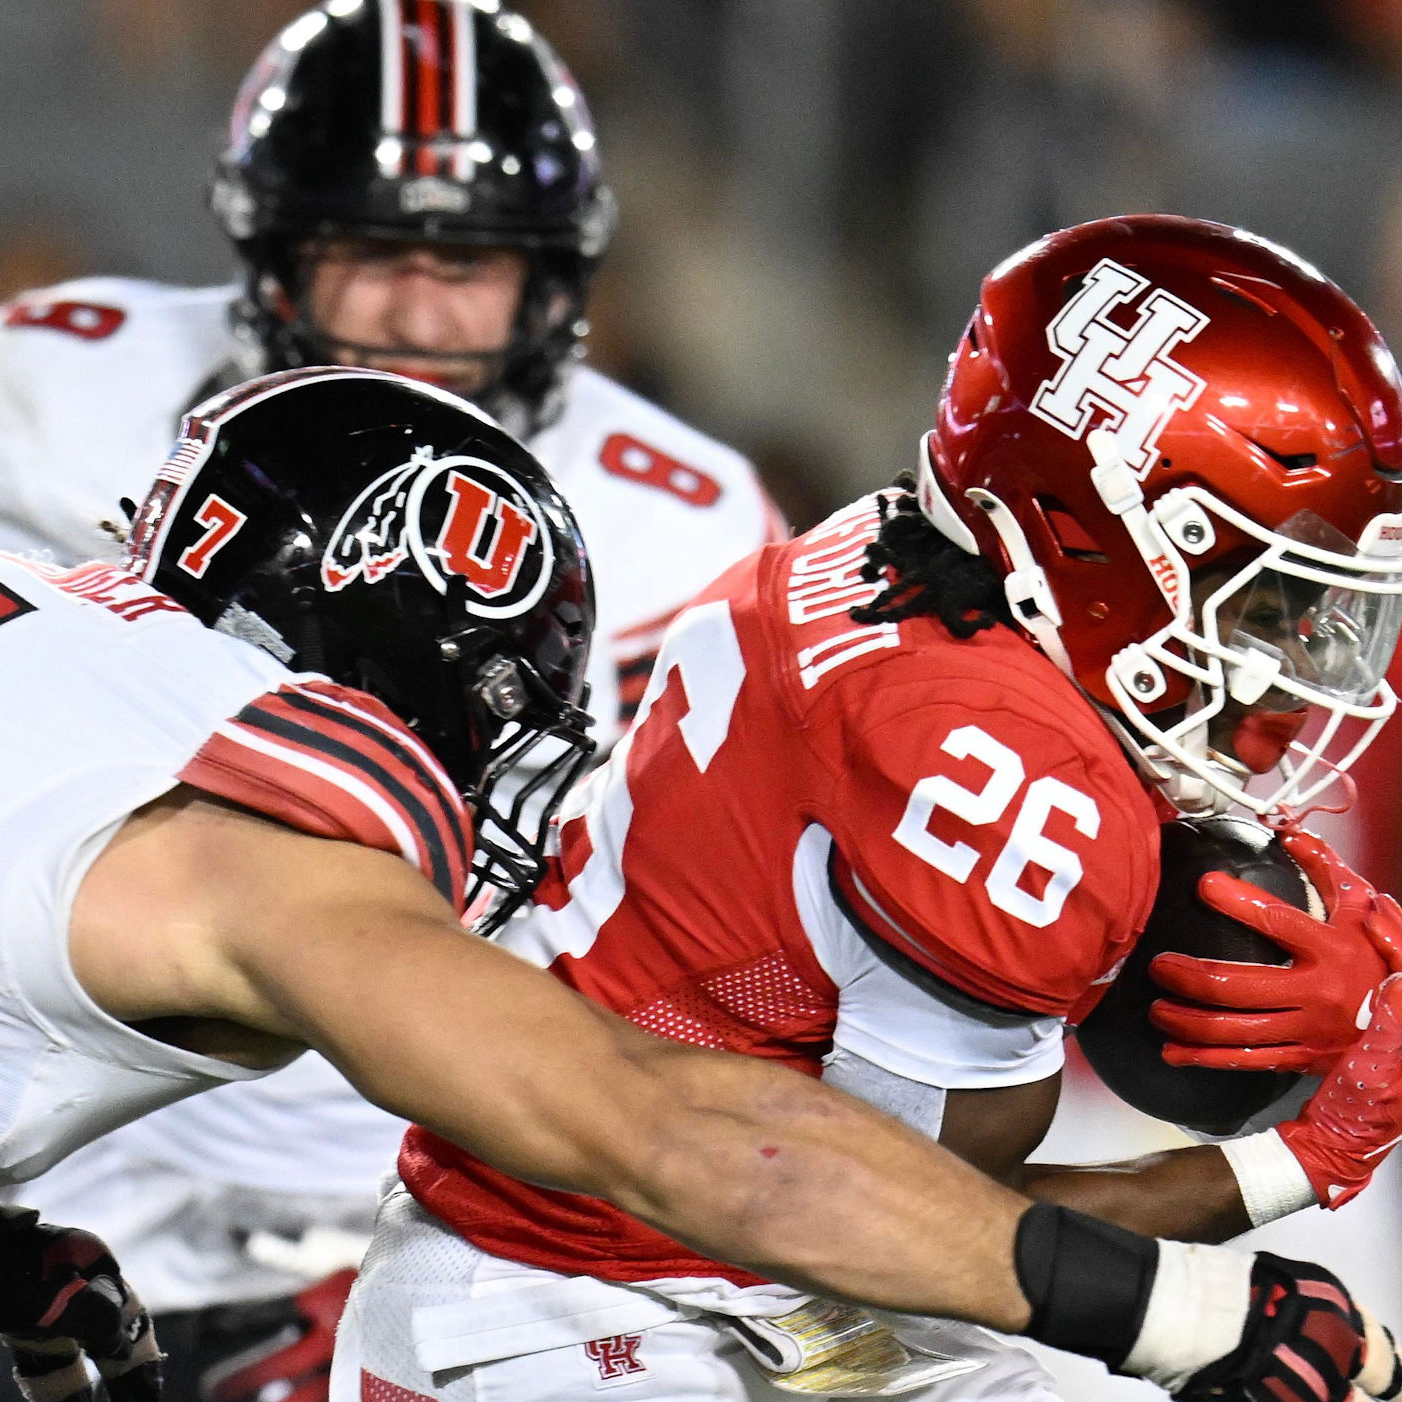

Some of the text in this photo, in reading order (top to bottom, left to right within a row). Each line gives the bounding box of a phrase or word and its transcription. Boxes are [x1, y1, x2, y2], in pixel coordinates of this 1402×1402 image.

[599, 432, 723, 507] 8
[177, 493, 248, 580] 7
[436, 469, 538, 600] U
[891, 724, 1101, 929] 26
